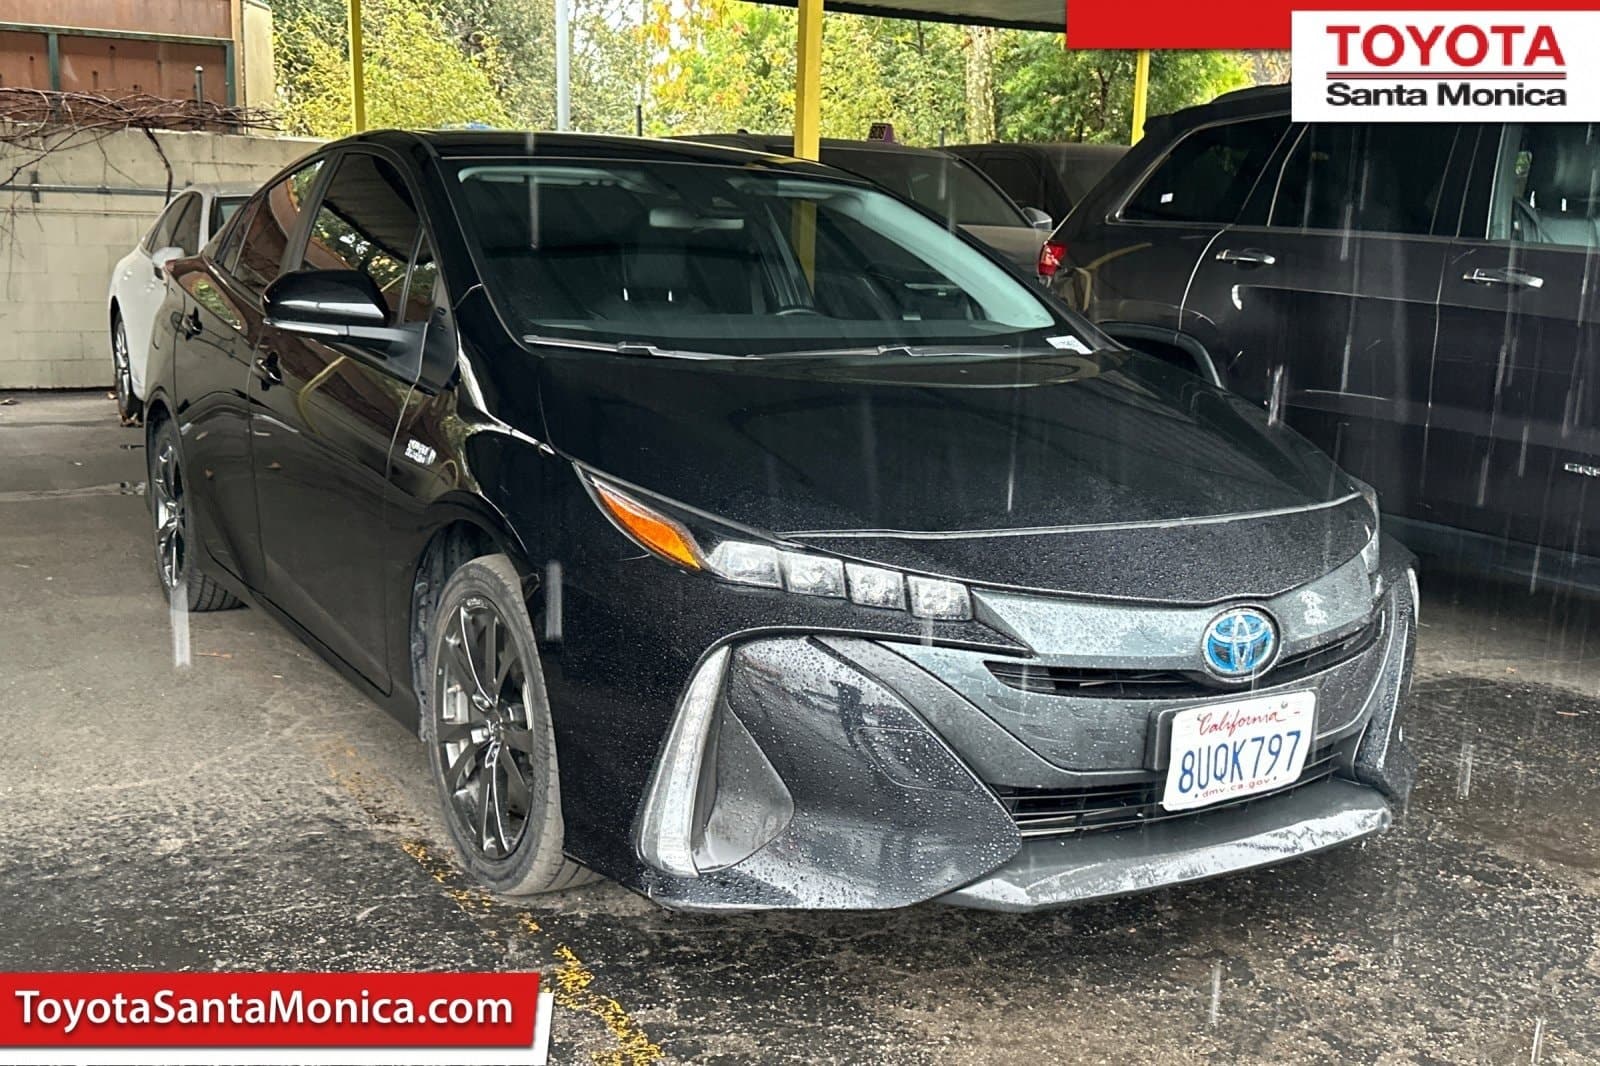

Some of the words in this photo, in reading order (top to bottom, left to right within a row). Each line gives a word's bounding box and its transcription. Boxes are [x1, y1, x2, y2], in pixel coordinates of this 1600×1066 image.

[1197, 708, 1287, 738] California
[1178, 730, 1301, 794] 8UQK797
[1202, 777, 1271, 799] dmv.ca.gov
